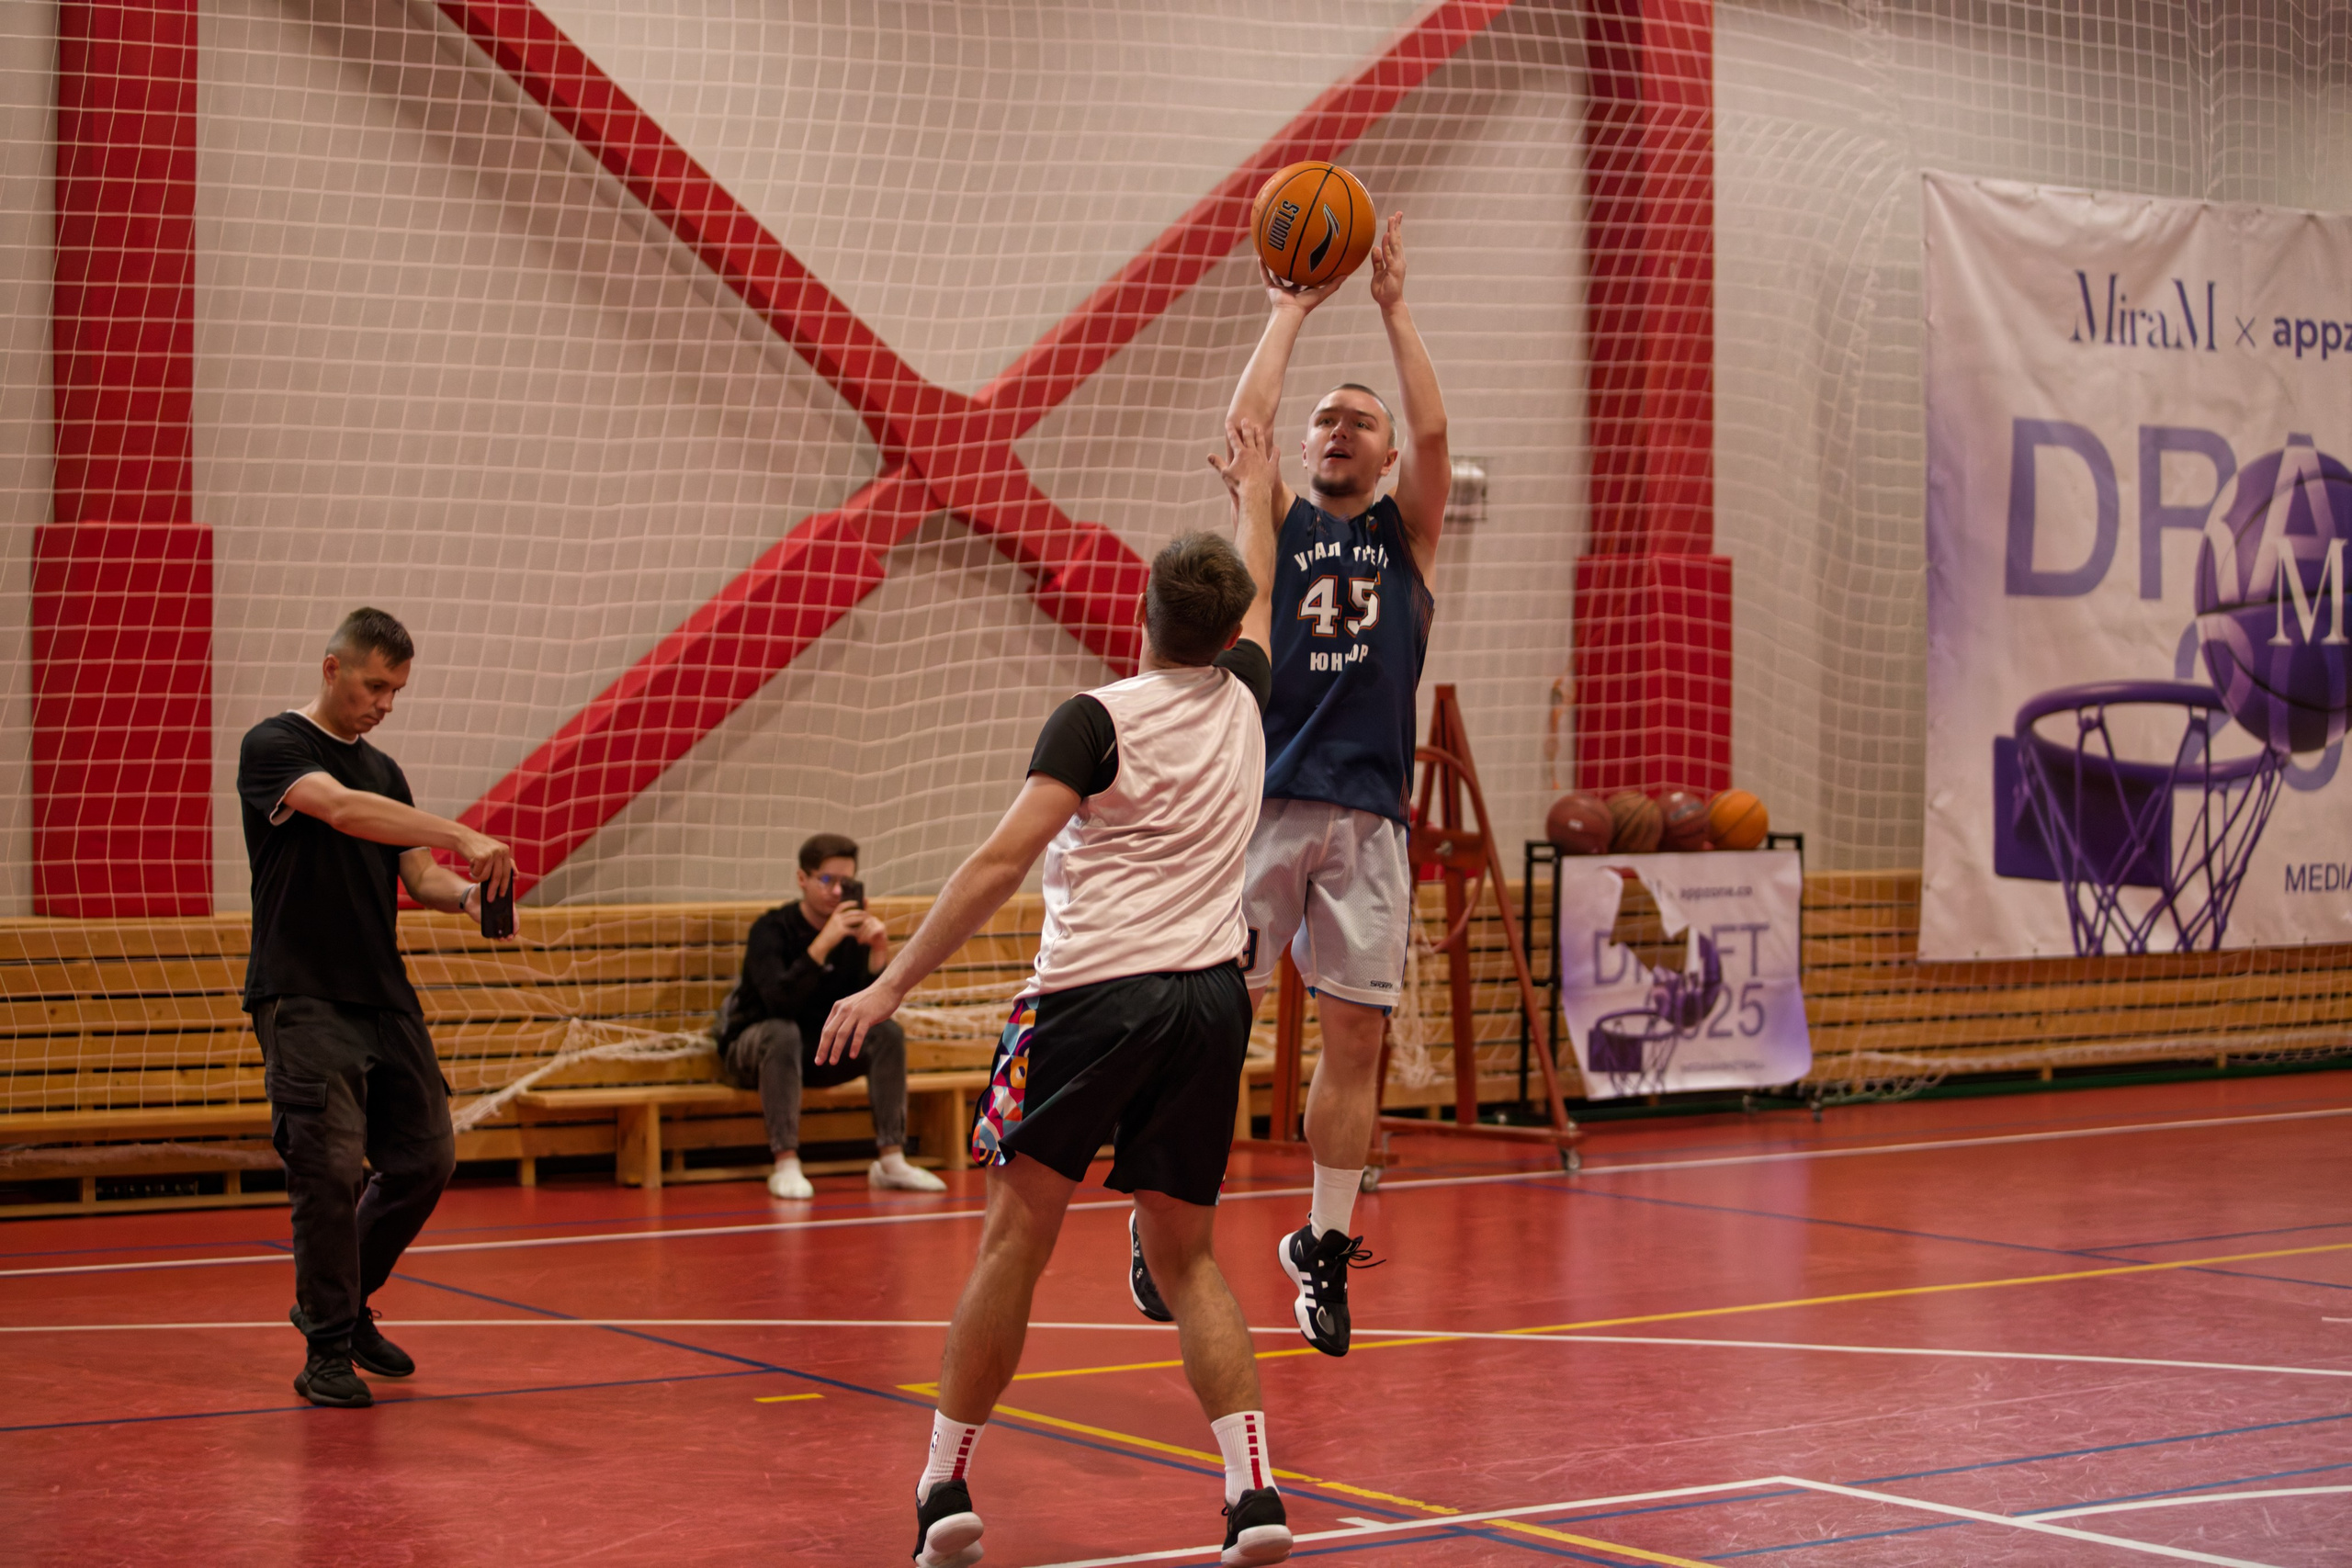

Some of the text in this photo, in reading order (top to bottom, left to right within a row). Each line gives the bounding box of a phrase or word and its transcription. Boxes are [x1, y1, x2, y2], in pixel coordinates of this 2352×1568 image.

[2068, 269, 2217, 352] MiraM
[1297, 572, 1381, 637] 45
[1593, 922, 1770, 986] DFT
